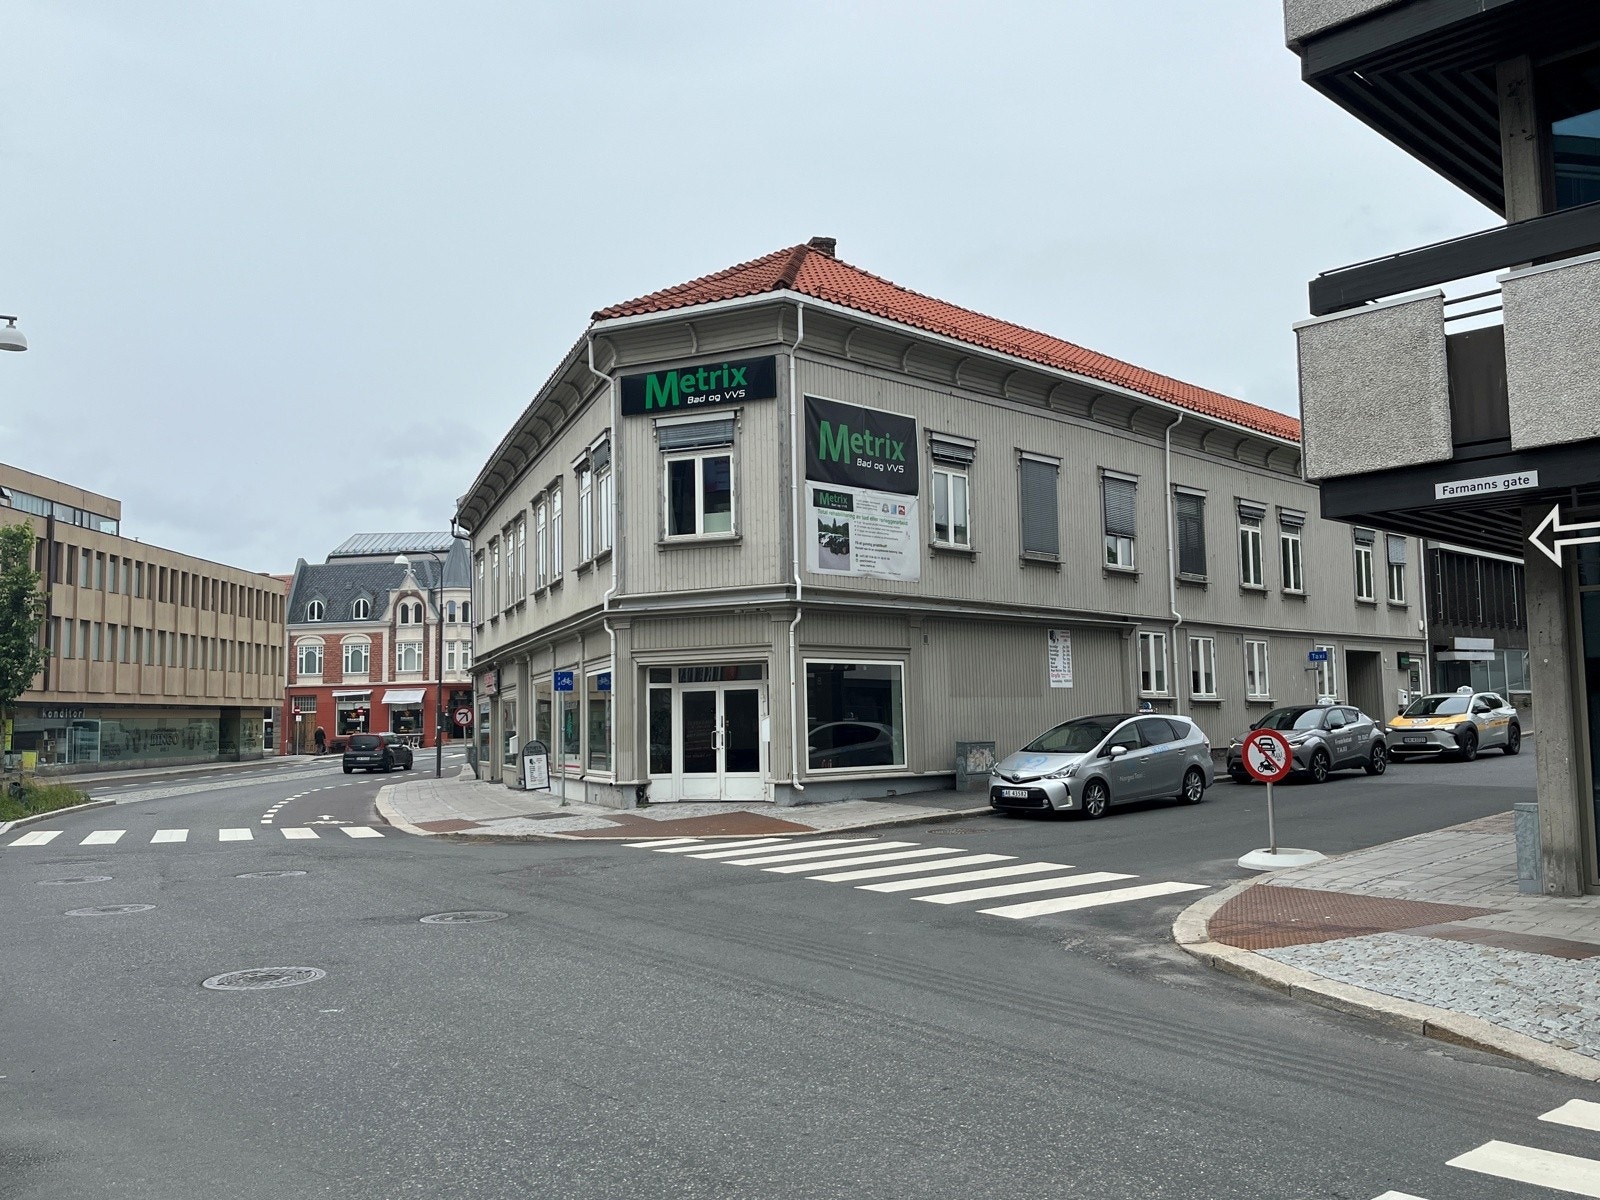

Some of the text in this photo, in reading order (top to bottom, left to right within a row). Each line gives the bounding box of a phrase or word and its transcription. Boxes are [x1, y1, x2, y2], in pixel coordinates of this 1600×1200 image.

[645, 363, 748, 409] Metrix
[687, 389, 746, 404] Bad og VVS
[819, 420, 906, 464] Metrix
[856, 458, 904, 473] Bad og VVS
[1442, 476, 1530, 495] Farmanns gate
[820, 491, 848, 505] Metrix
[150, 733, 178, 746] BINGO
